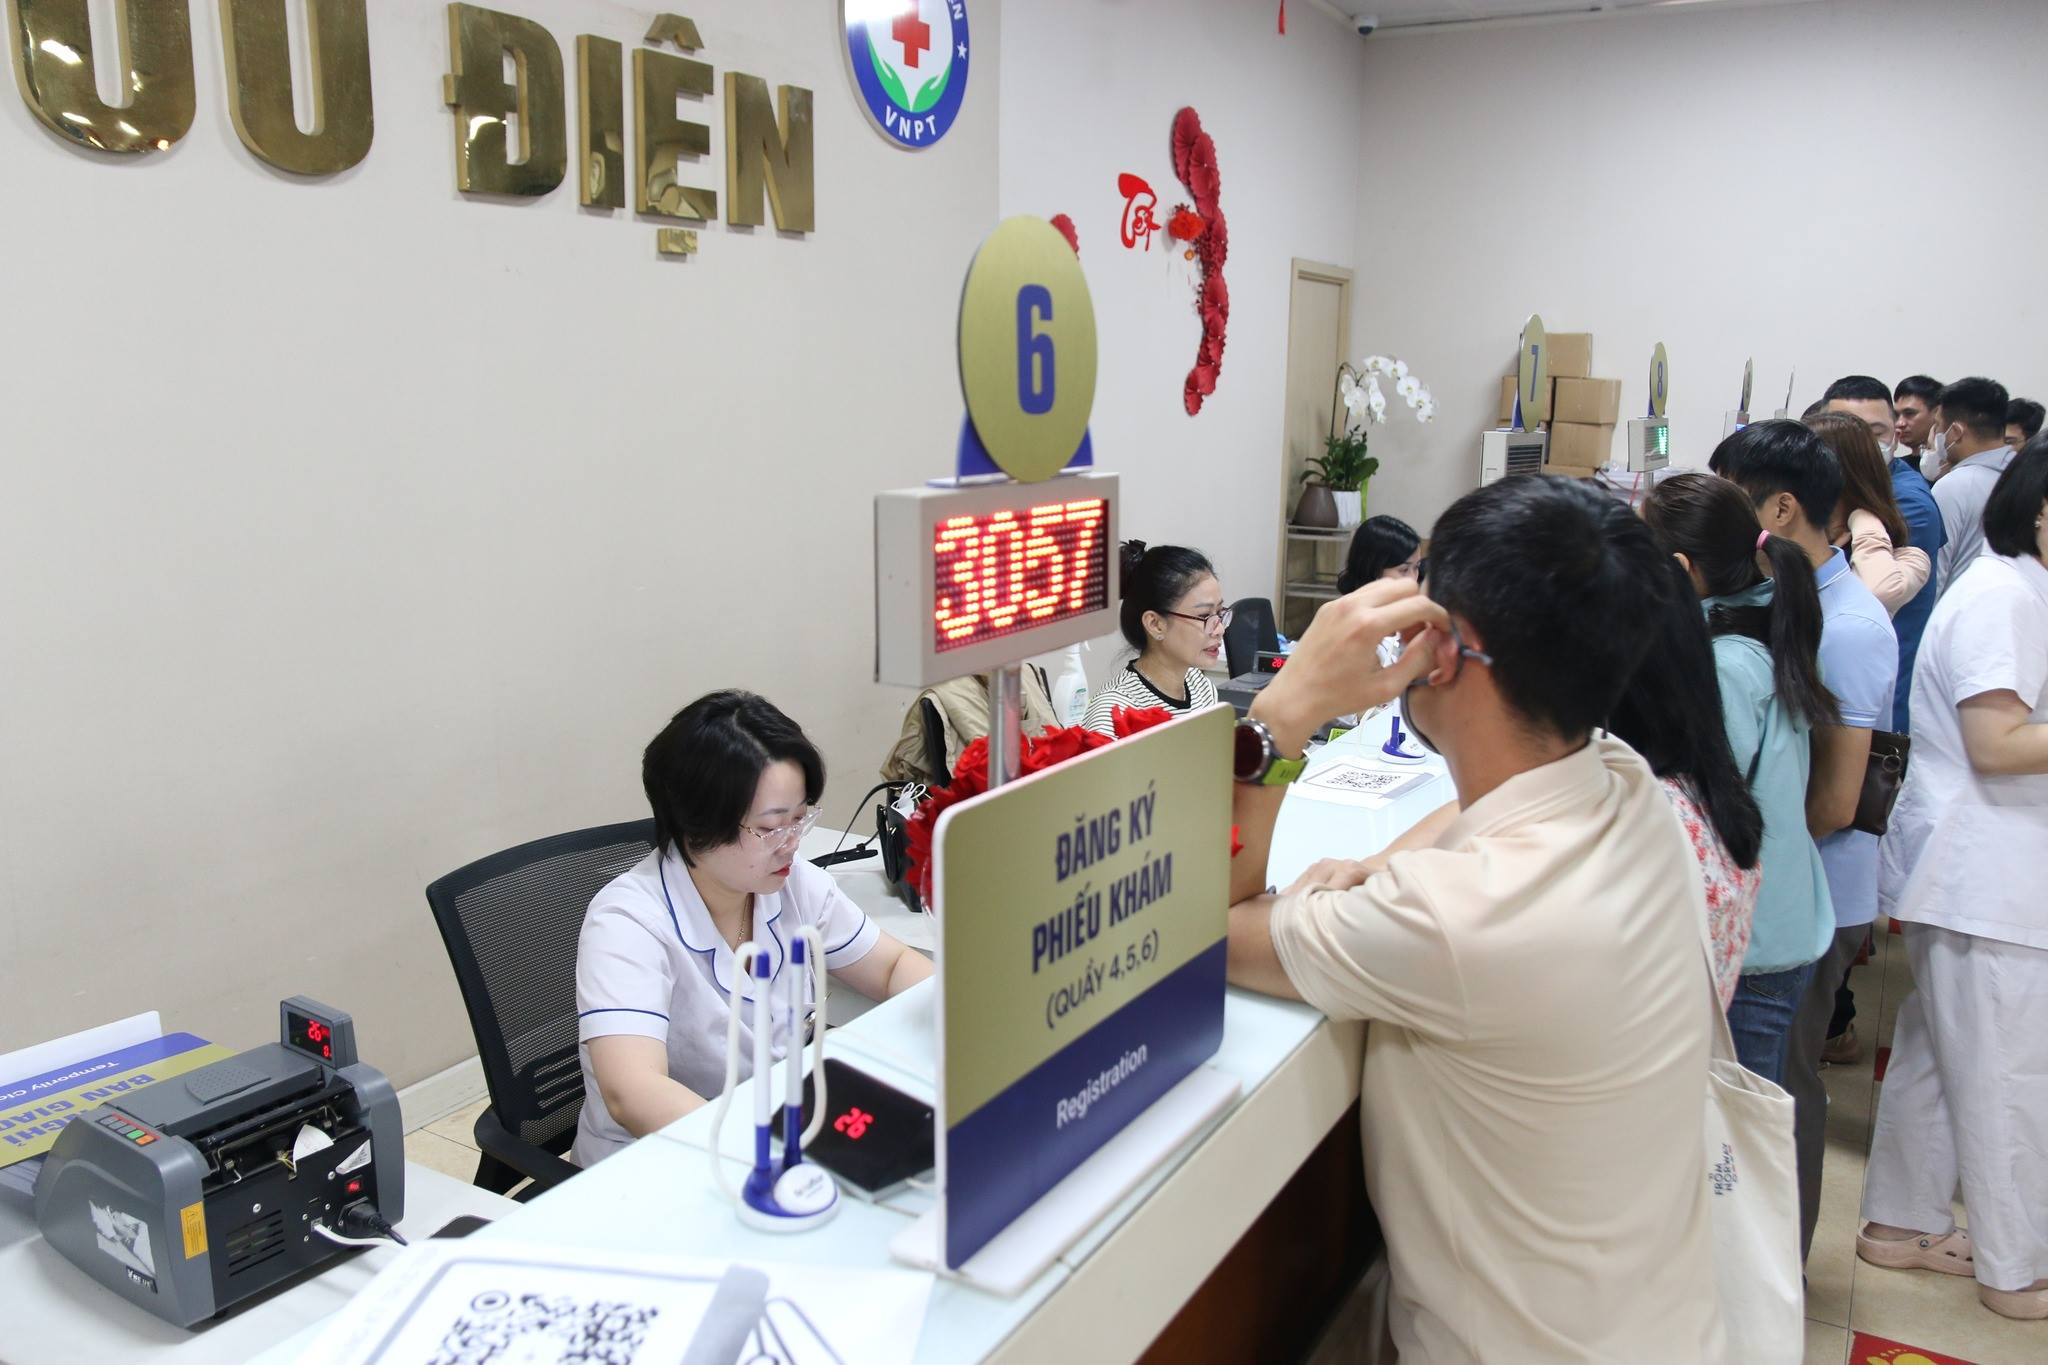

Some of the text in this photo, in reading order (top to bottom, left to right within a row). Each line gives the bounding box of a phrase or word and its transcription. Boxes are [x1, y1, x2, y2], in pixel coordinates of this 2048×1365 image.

[443, 1, 815, 255] ĐIỆN
[885, 105, 937, 140] VNPT
[1016, 283, 1056, 415] 6
[1530, 344, 1539, 402] 7
[934, 499, 1102, 640] 3057
[1055, 779, 1157, 883] ĐĂNG KÝ
[1031, 850, 1173, 975] PHIẾU KHÁM
[1108, 929, 1160, 983] 4,5,6)
[32, 1062, 120, 1091] Temporily
[1056, 1044, 1147, 1129] Registration
[1714, 1162, 1724, 1196] FROM
